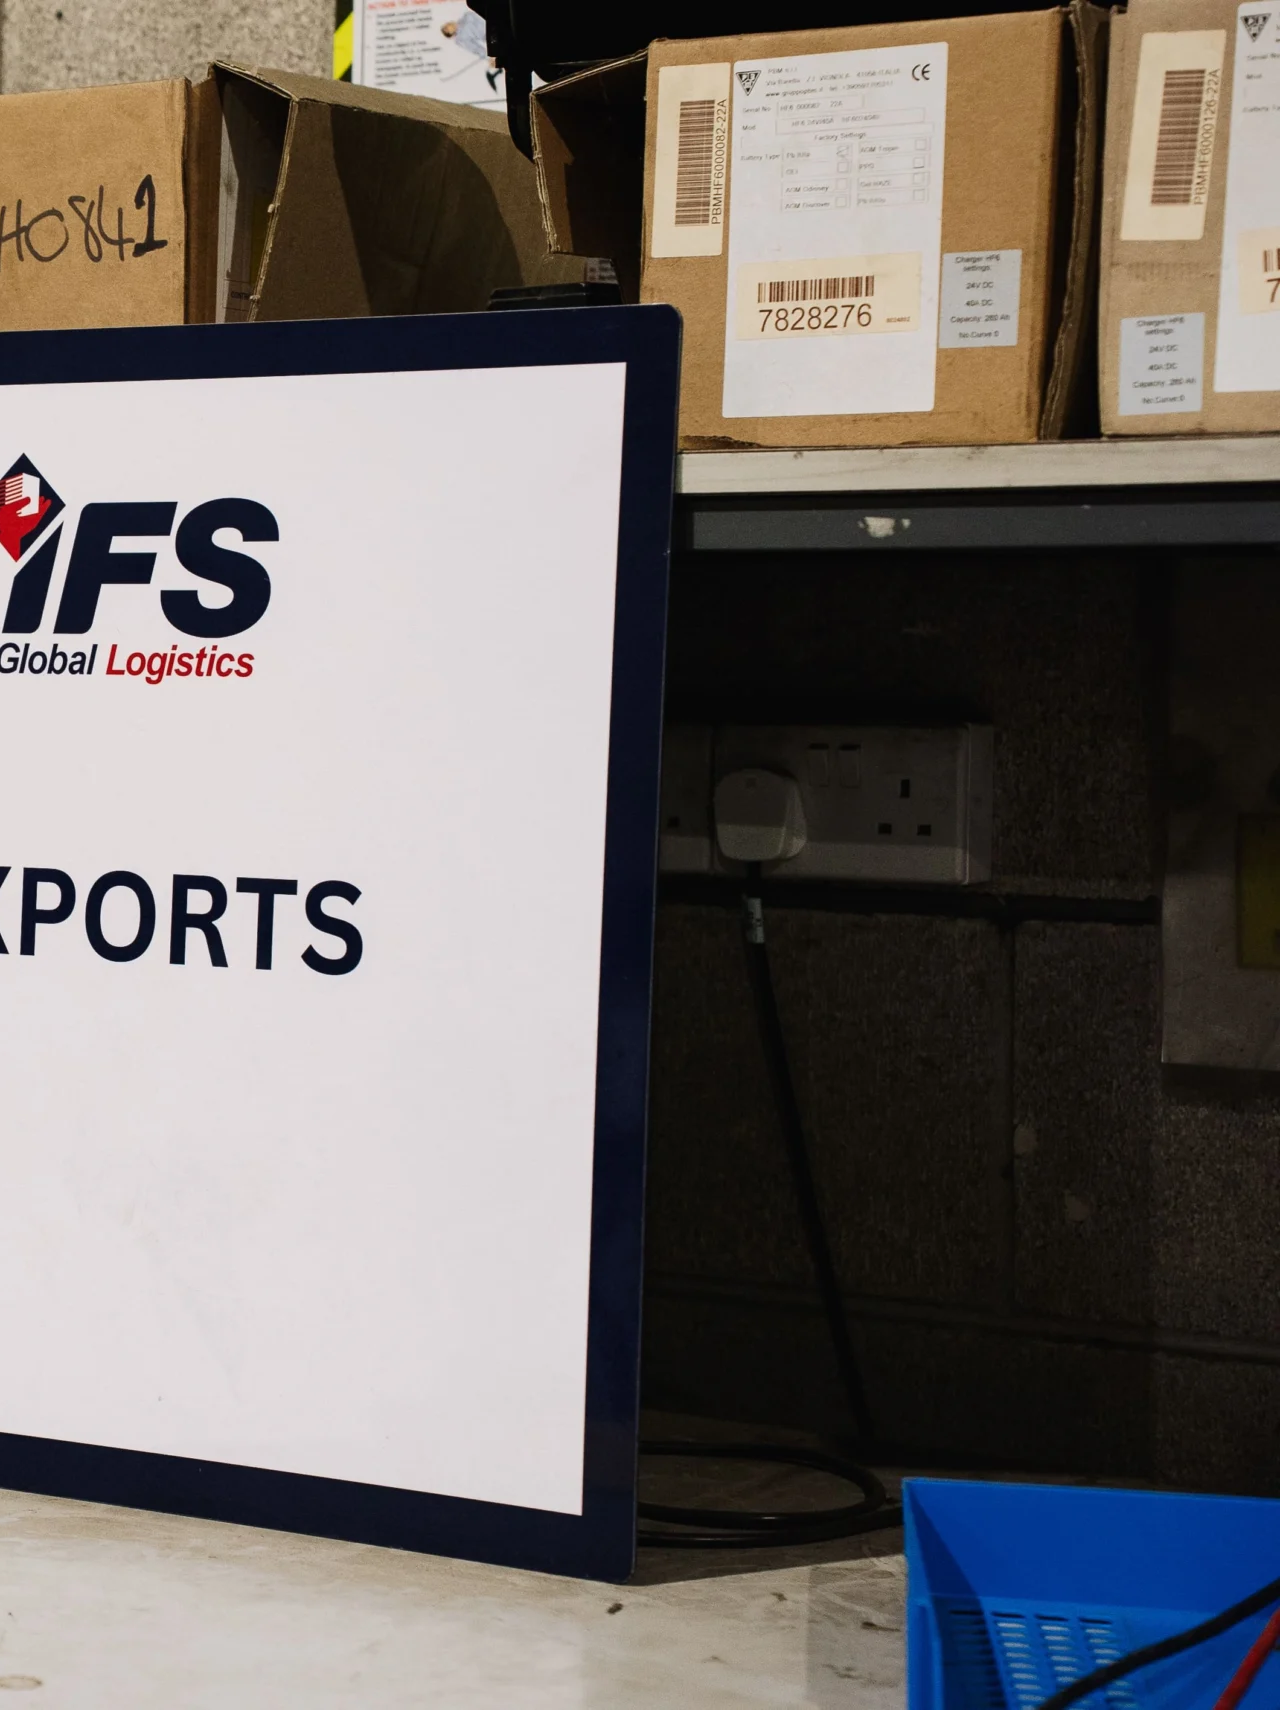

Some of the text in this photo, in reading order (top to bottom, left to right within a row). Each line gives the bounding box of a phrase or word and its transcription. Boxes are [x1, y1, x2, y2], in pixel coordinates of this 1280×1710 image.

[711, 99, 728, 225] PBMHF6000082-22A
[758, 303, 873, 333] 7828276
[1, 496, 280, 639] IFS
[105, 643, 255, 686] Logistics
